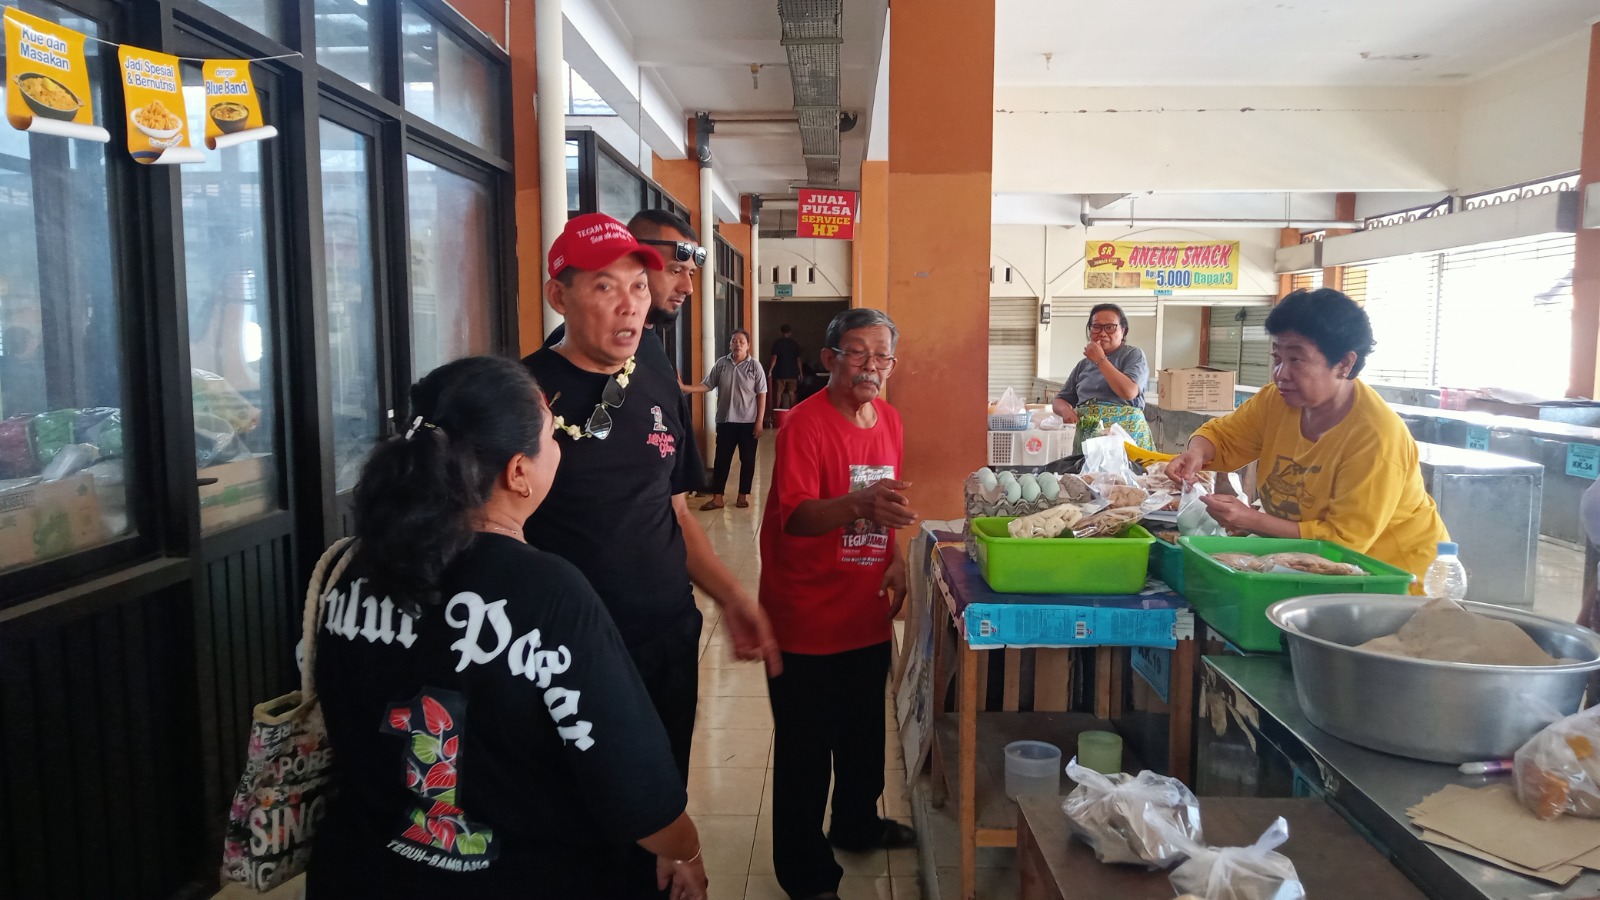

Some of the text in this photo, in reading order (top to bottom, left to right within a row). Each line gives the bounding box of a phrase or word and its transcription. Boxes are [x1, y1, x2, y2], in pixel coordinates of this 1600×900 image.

[22, 27, 66, 53] Kue dan
[20, 42, 69, 70] Masakan
[124, 57, 174, 78] Jadi Spesial
[215, 68, 235, 78] dengan
[126, 72, 176, 92] & Bernutrisi
[205, 80, 248, 94] Blue Band
[808, 194, 847, 205] JUAL
[802, 204, 851, 215] PULSA
[801, 215, 850, 225] SERVICE
[812, 224, 839, 236] HP
[1100, 246, 1112, 255] SR
[1128, 244, 1233, 268] ANEKA SNACK
[1157, 270, 1192, 288] 5.000
[1193, 272, 1223, 285] Dapat
[1226, 271, 1233, 284] 3
[1572, 460, 1593, 471] KK.34
[445, 591, 595, 751] Pasar
